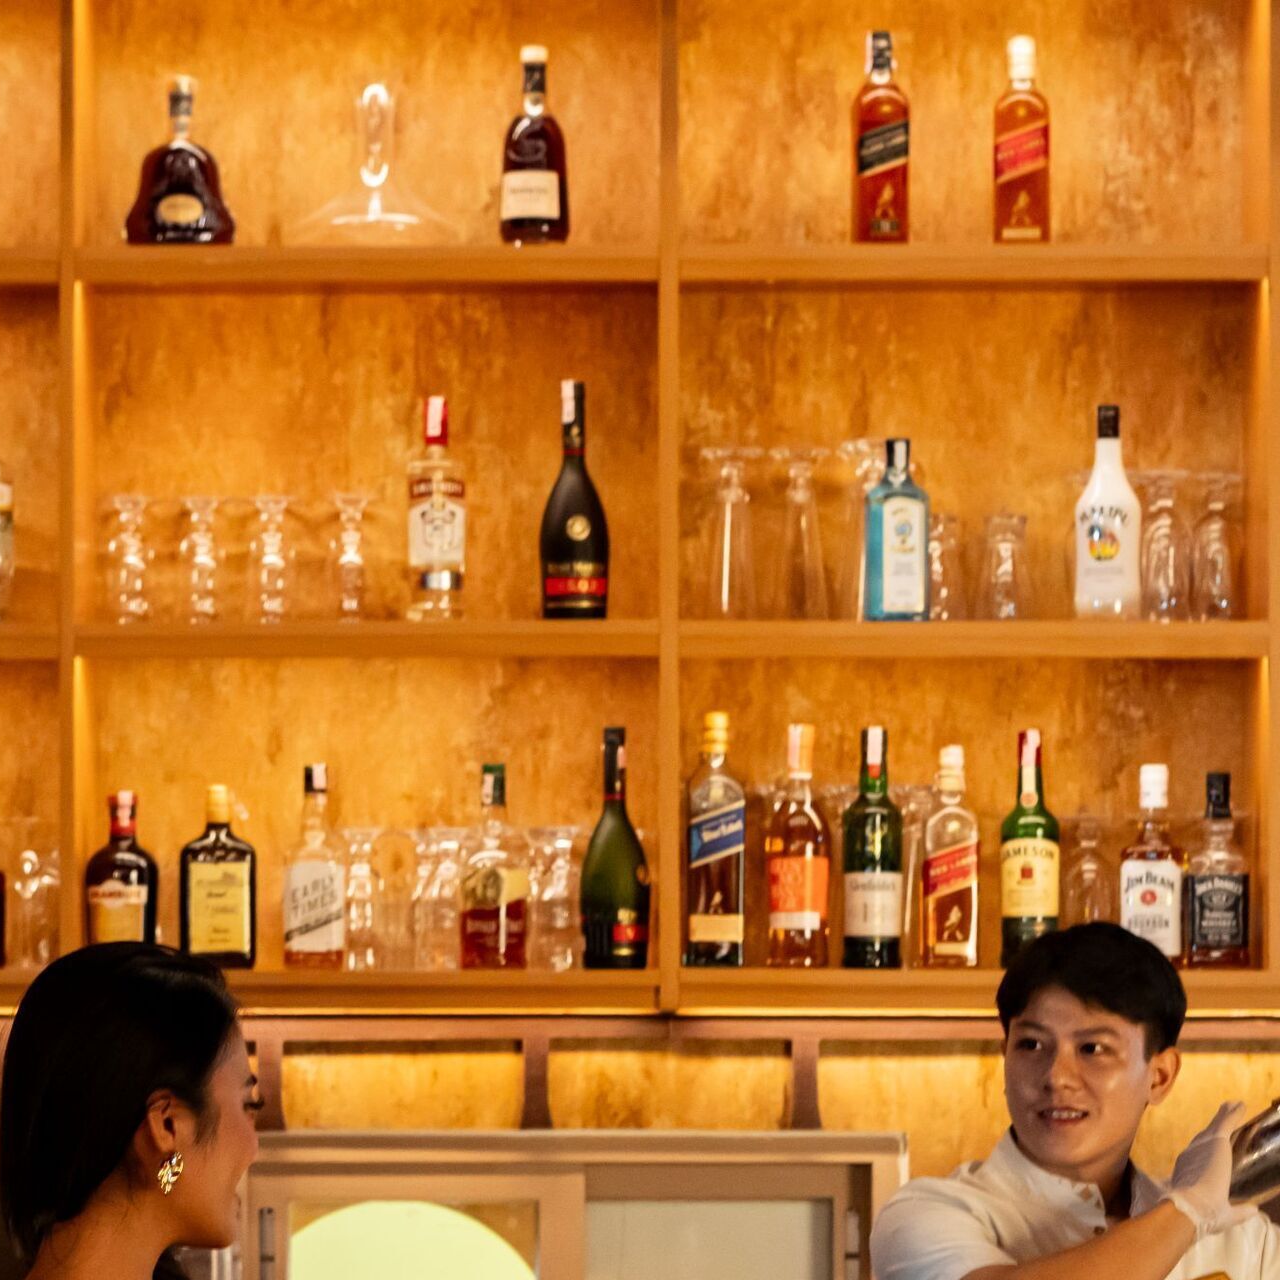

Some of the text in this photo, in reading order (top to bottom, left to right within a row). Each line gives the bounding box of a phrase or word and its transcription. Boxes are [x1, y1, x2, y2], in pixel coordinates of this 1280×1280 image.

[290, 873, 337, 901] EARLY
[1124, 871, 1175, 893] JIM BEAM
[291, 889, 339, 918] TIMES
